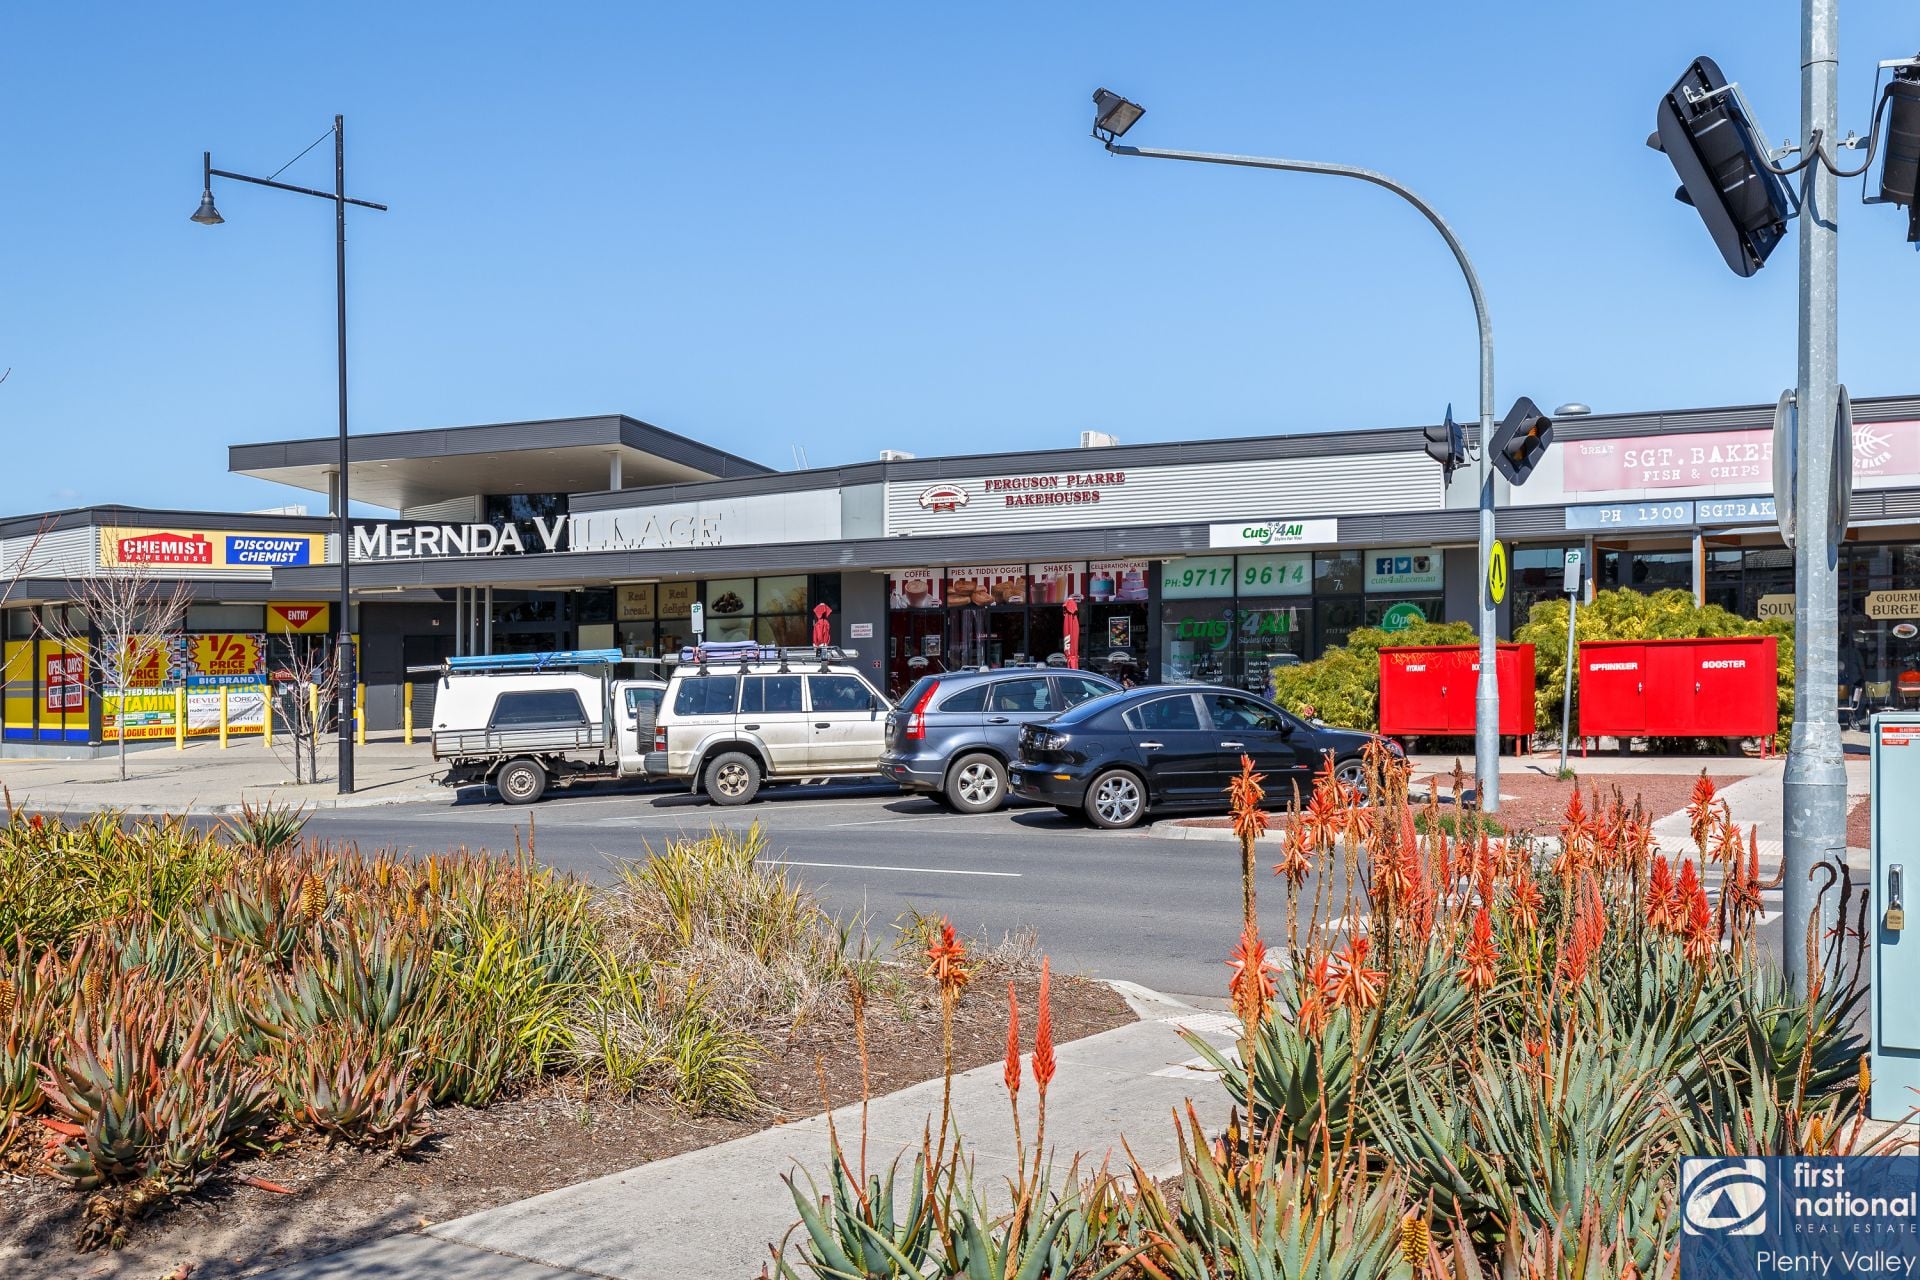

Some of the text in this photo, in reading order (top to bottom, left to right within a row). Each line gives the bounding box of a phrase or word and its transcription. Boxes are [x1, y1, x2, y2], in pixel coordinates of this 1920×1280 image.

[1643, 465, 1760, 482] FISH & CHIPS
[984, 472, 1126, 491] FERGUSON PLARRE
[1005, 491, 1101, 506] BAKEHOUSES
[1600, 502, 1776, 522] PH 1300 SGTBAK
[352, 522, 526, 558] MERNDA
[124, 540, 206, 554] CHEMIST
[234, 540, 302, 552] DISCOUNT
[124, 554, 207, 562] WAREHOUSE
[239, 552, 297, 562] CHEMIST
[1568, 554, 1579, 563] 2P
[1000, 566, 1023, 574] OGGIE
[1044, 564, 1073, 572] SHAKES
[1091, 562, 1128, 570] CELEBRATION
[904, 570, 931, 578] COFFEE
[1164, 564, 1304, 588] PH: 9717 9614
[628, 590, 646, 601] Real
[668, 588, 688, 600] Real
[288, 610, 309, 620] ENTRY
[1760, 604, 1795, 616] SOUV
[1872, 604, 1920, 616] BURGE
[1390, 613, 1410, 628] Ope
[210, 660, 245, 668] PRICE
[1406, 664, 1426, 672] HYDRANT
[1590, 662, 1638, 671] SPRINKLER
[1702, 660, 1746, 669] BOOSTER
[129, 669, 159, 679] PRICE
[130, 680, 144, 688] OFF
[199, 676, 255, 685] BIG BRAND
[144, 688, 156, 696] BIG
[188, 684, 264, 694] COSETICS
[104, 695, 176, 714] VITAMIN
[148, 728, 162, 736] OUT
[164, 727, 176, 736] NO
